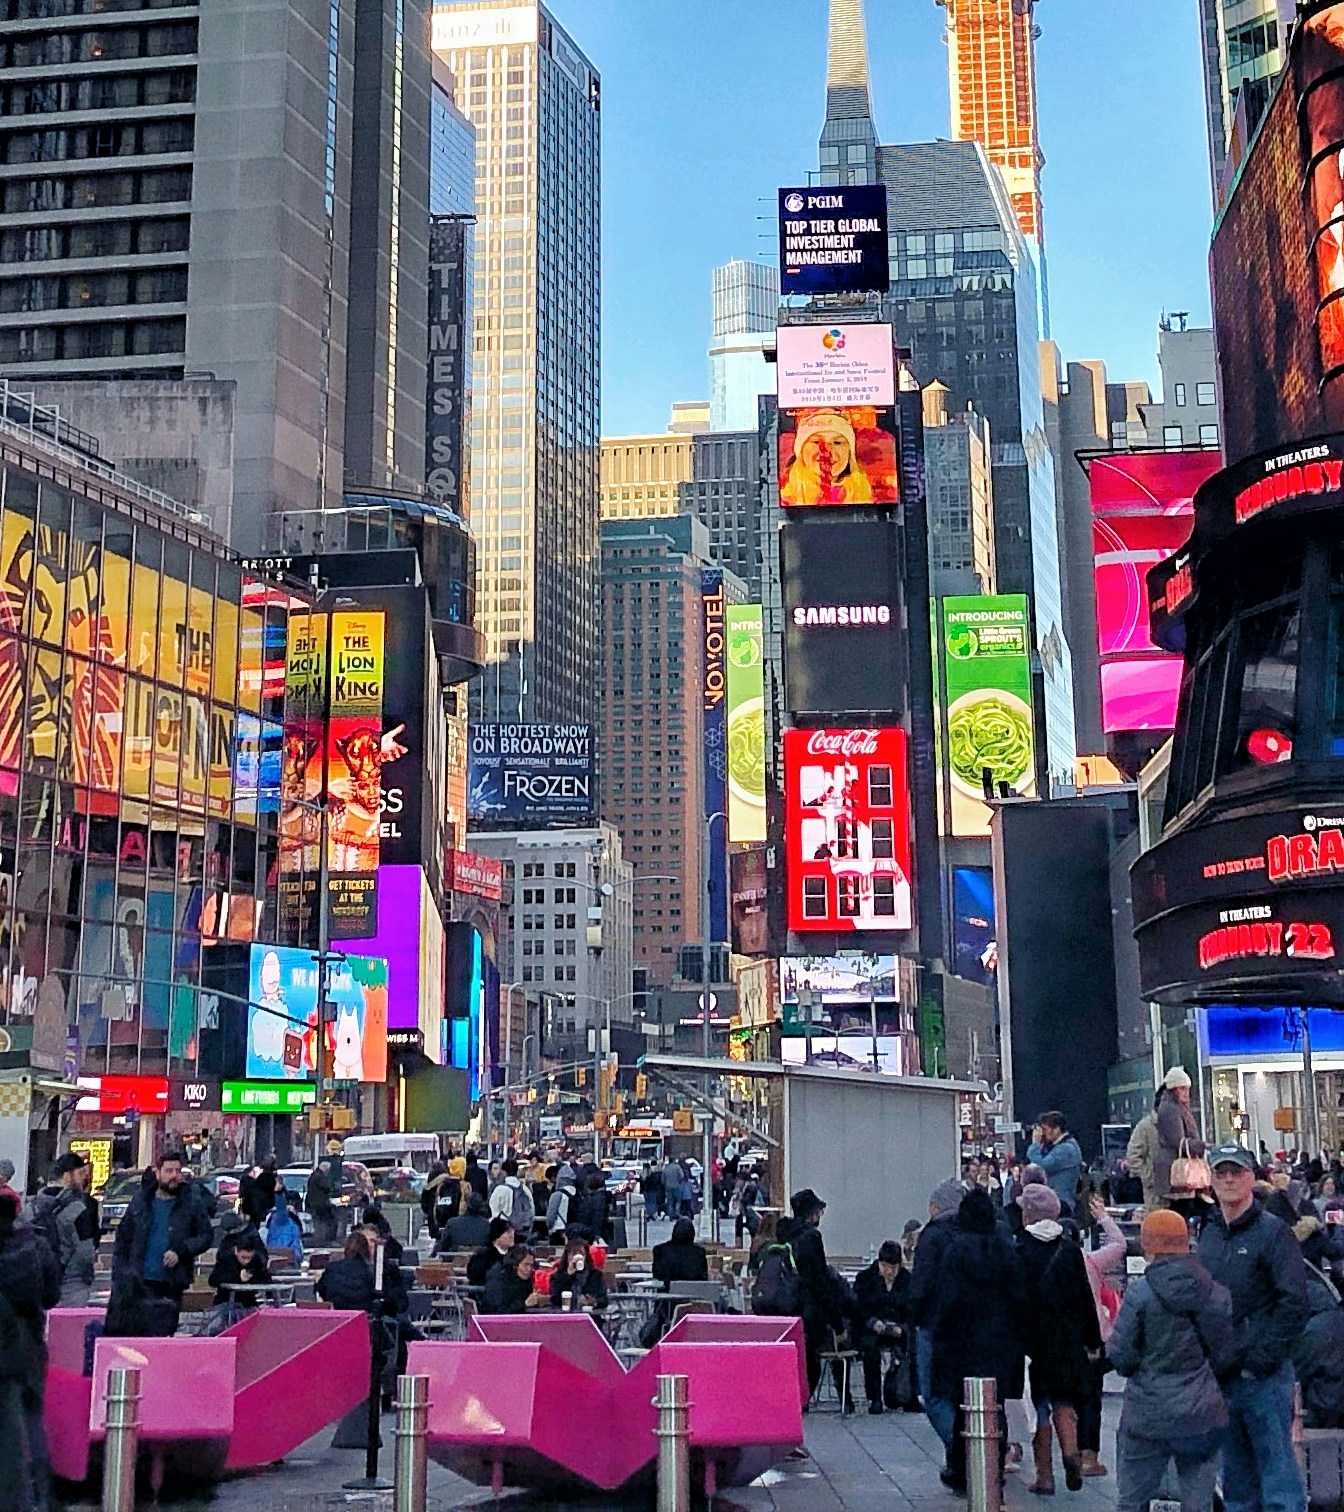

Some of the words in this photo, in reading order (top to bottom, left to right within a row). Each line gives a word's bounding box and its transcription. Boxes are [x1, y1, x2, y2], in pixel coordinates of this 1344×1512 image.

[808, 195, 843, 208] PGIM
[785, 221, 807, 234] TOP
[809, 220, 835, 233] TIER
[838, 219, 881, 232] GLOBAL
[786, 235, 855, 249] INVESTMENT
[786, 250, 862, 265] MANAGEMENT
[430, 262, 457, 415] TIMES
[1264, 459, 1275, 472] IN
[1276, 445, 1329, 469] THEATERS
[1235, 459, 1343, 524] FEBRUARY
[794, 606, 890, 625] SAMSUNG
[948, 611, 1023, 622] INTRODUCING
[343, 636, 369, 648] THE
[338, 652, 374, 673] LION
[336, 676, 379, 701] KING
[474, 724, 496, 737] THE
[500, 724, 550, 738] HOTTEST
[554, 725, 589, 738] SNOW
[473, 738, 495, 753] ON
[501, 738, 589, 754] BROADWAY!
[504, 770, 589, 802] FROZEN
[1219, 911, 1227, 923] IN
[1228, 905, 1271, 922] THEATERS
[1285, 922, 1335, 960] 22
[387, 1034, 408, 1043] WISS
[184, 1084, 207, 1101] KIKO
